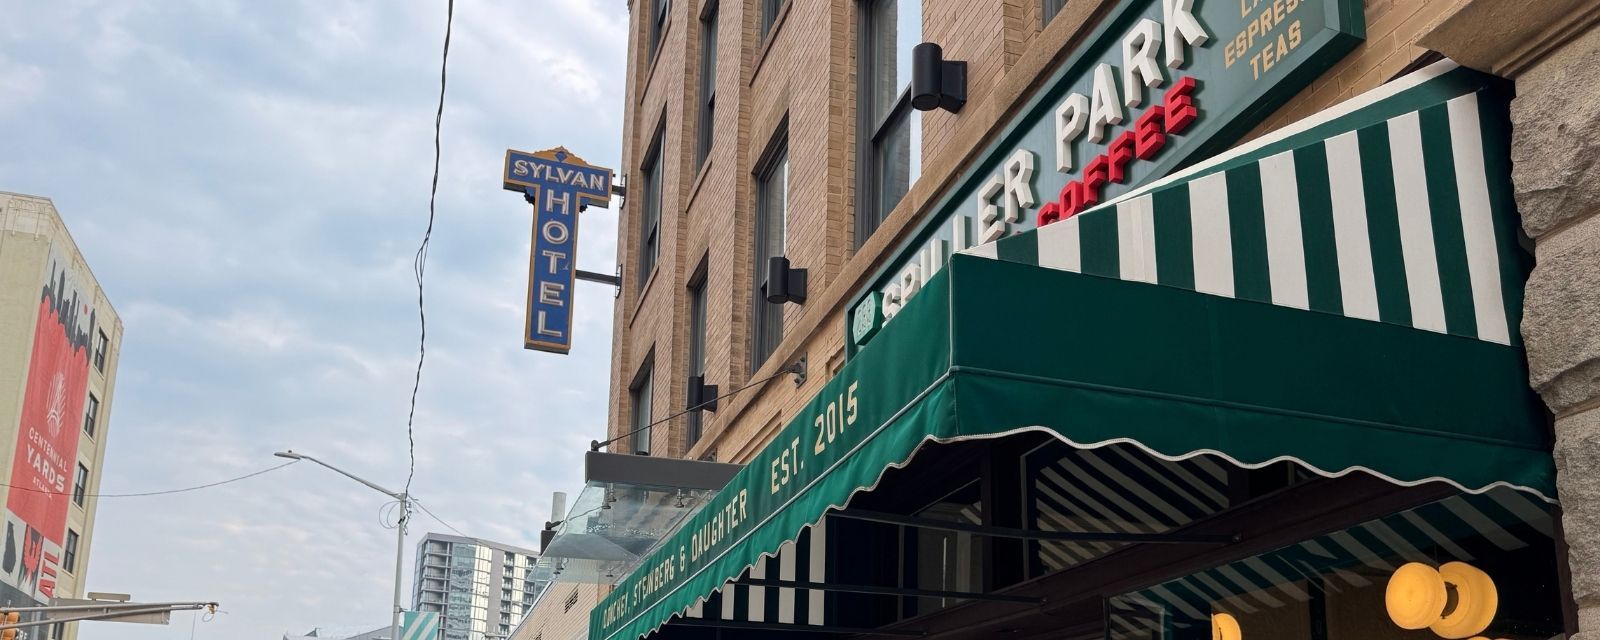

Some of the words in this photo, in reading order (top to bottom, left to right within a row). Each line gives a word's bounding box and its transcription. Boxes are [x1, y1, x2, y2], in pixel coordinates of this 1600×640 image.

[1249, 20, 1301, 81] TEAS
[1056, 0, 1209, 174] PARK
[513, 159, 605, 191] SYLVAN
[536, 188, 570, 338] HOTEL
[27, 443, 65, 493] YARDS
[28, 426, 67, 473] CENTENNIAL
[691, 488, 748, 563] DAUGHTER
[771, 436, 804, 495] EST.
[814, 380, 859, 456] 2015
[38, 551, 60, 598] ATL
